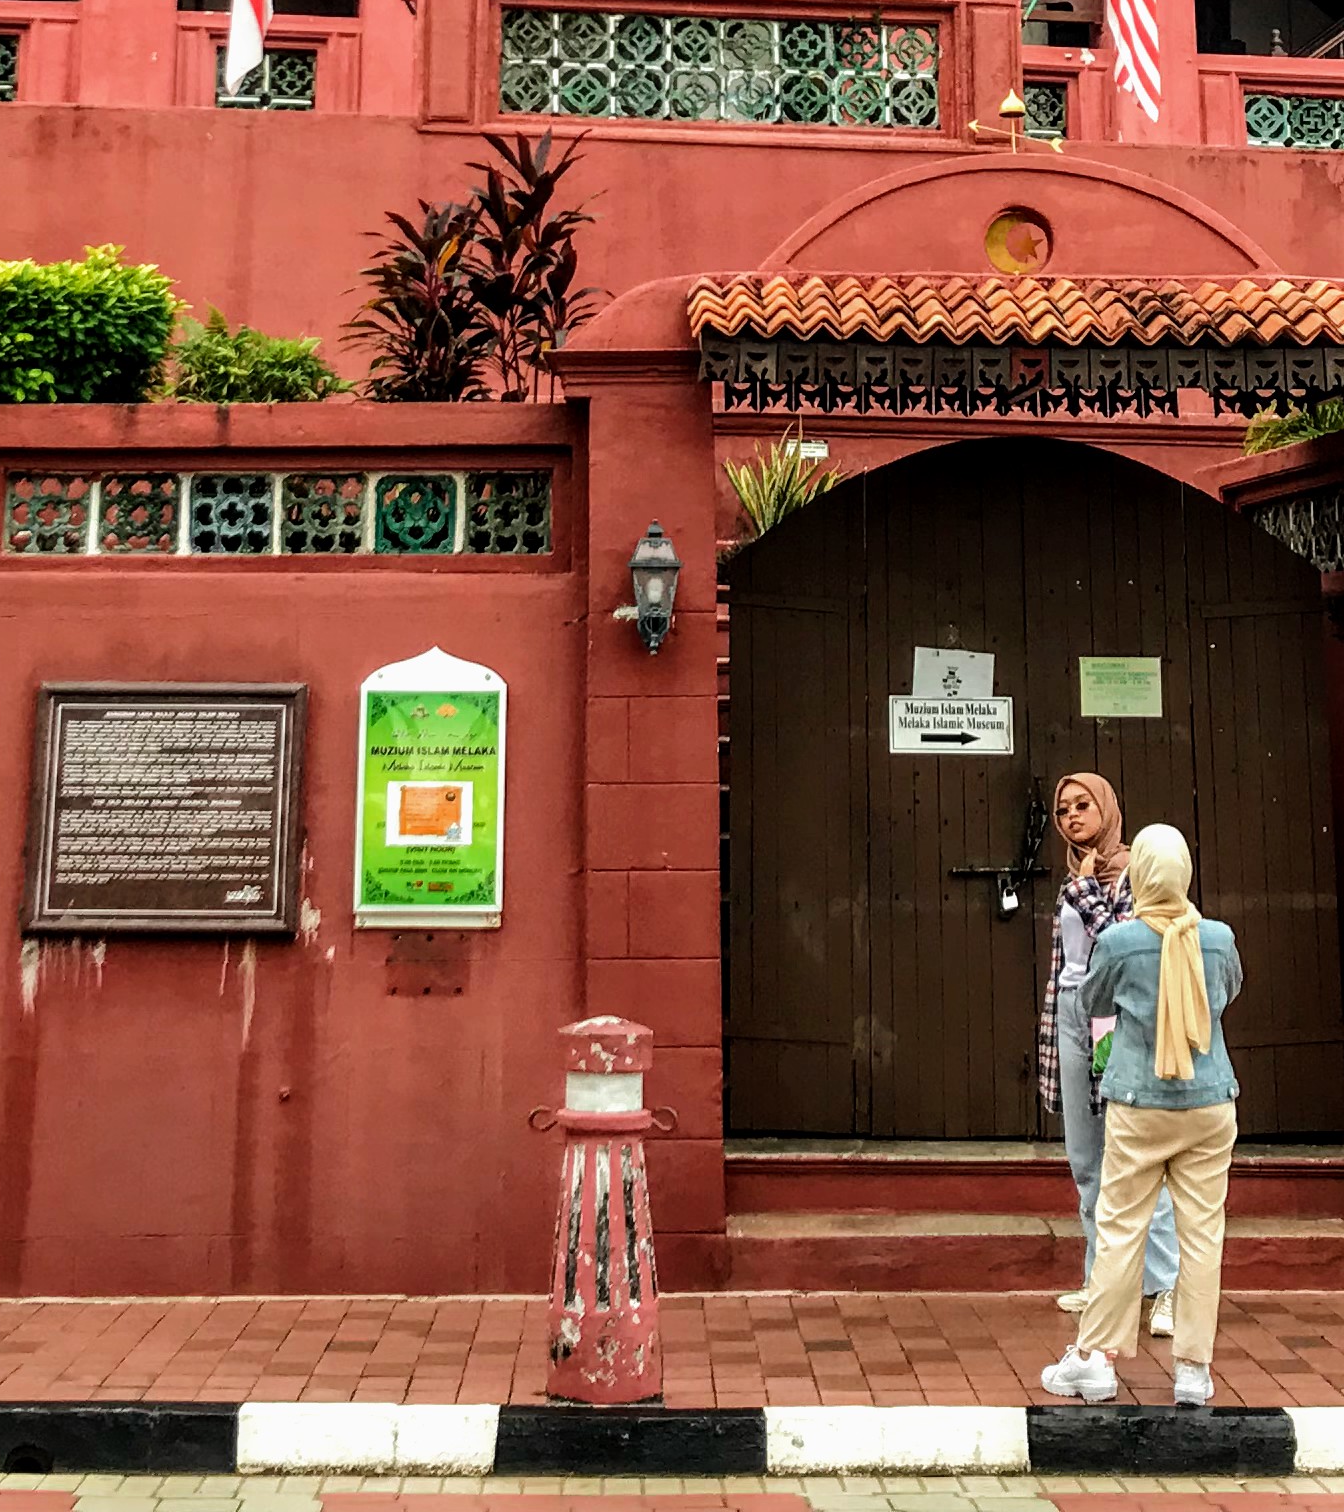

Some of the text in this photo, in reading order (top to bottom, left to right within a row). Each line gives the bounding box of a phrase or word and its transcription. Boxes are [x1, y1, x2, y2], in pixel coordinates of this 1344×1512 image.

[904, 702, 998, 716] Muzium Islam Melaka
[898, 716, 1005, 730] Melaka Islamic Museum
[371, 746, 497, 756] MUZIUM ISLAM MELAKA
